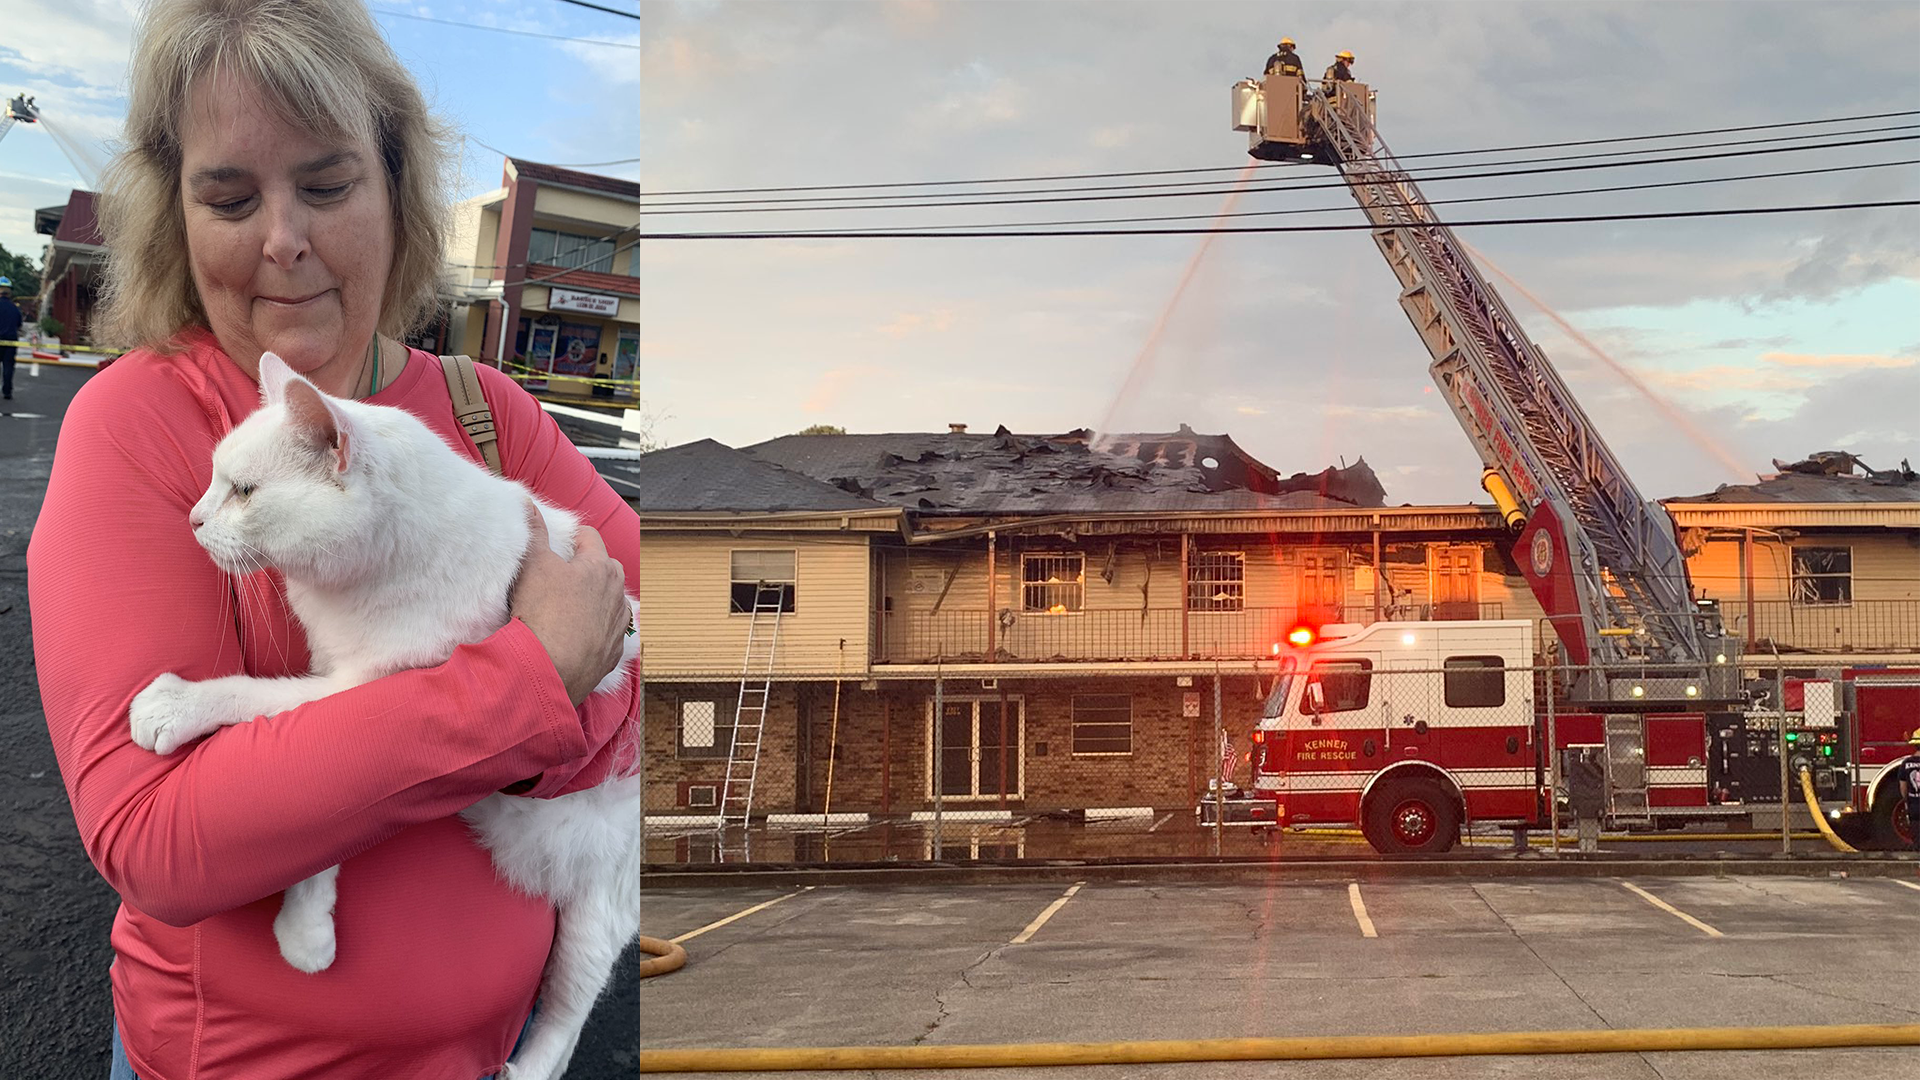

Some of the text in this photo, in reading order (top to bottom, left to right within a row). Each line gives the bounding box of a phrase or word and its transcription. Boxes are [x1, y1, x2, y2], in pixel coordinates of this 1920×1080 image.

[1304, 739, 1348, 751] KENNER
[1297, 751, 1357, 760] FIRE RESCUE
